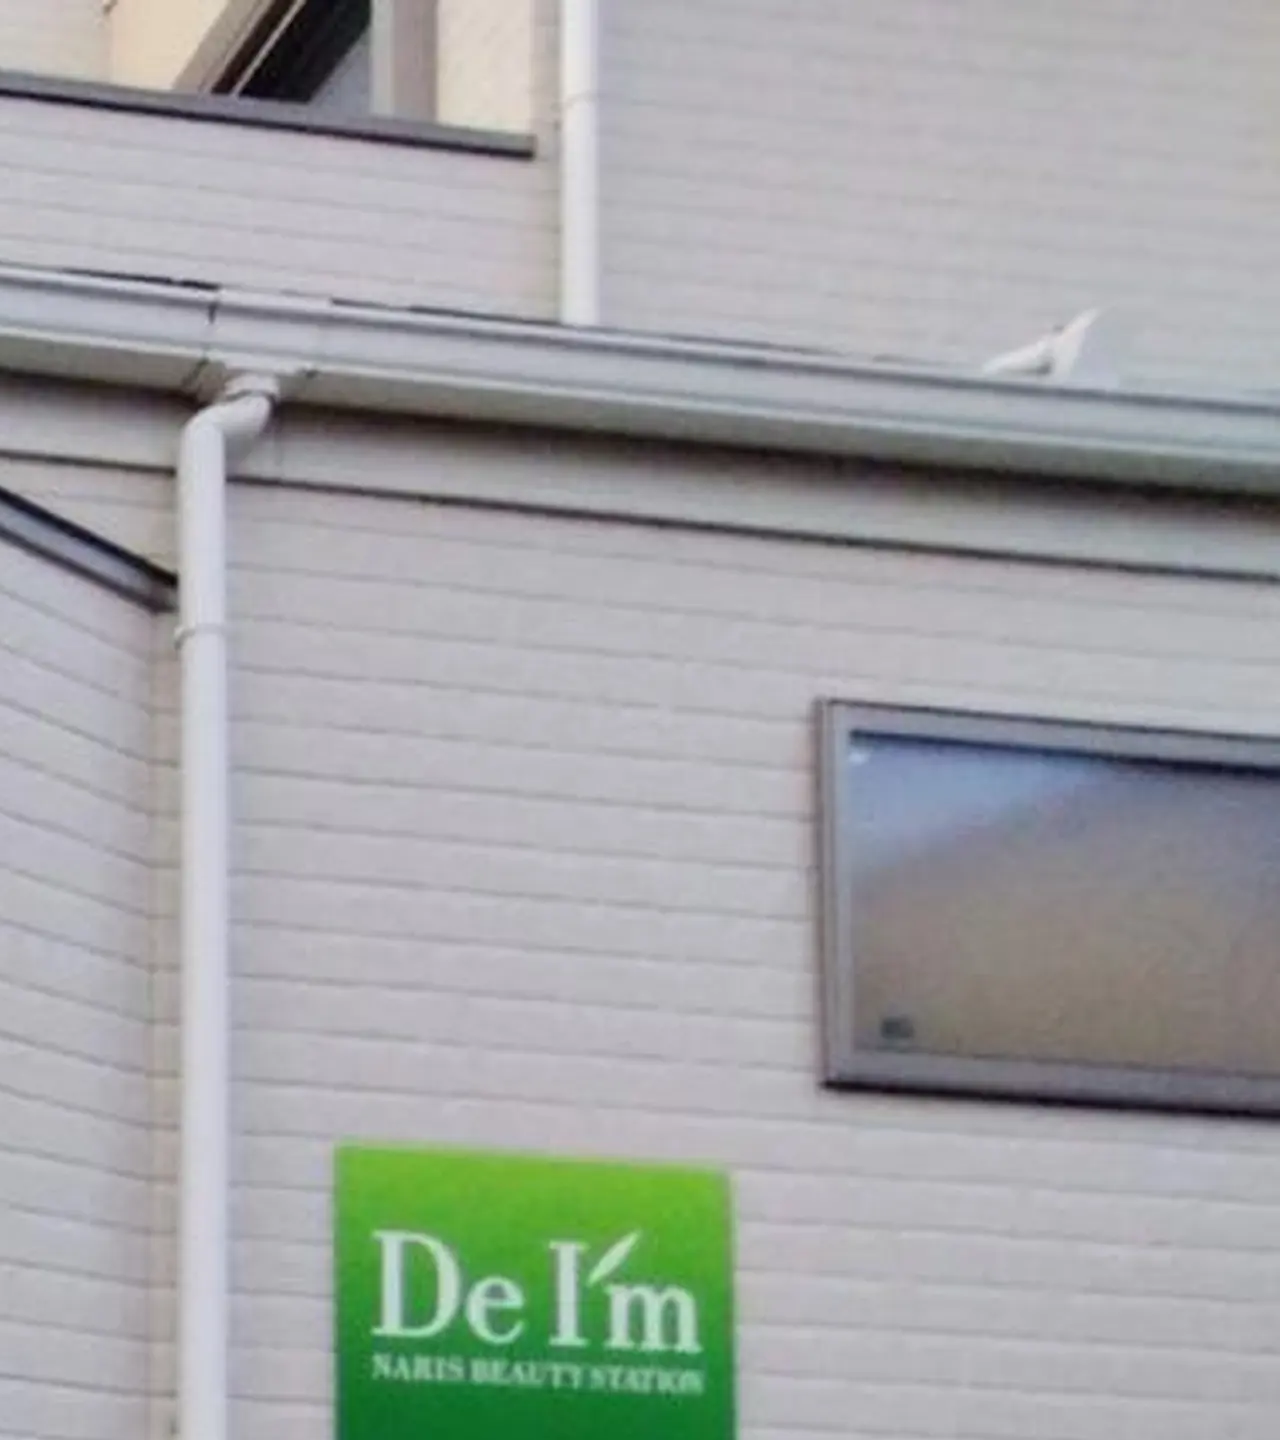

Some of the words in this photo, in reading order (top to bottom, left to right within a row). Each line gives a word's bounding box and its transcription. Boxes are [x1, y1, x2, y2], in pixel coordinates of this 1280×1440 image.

[371, 1229, 526, 1345] De
[548, 1229, 703, 1354] I'm
[372, 1352, 464, 1382] NARIS
